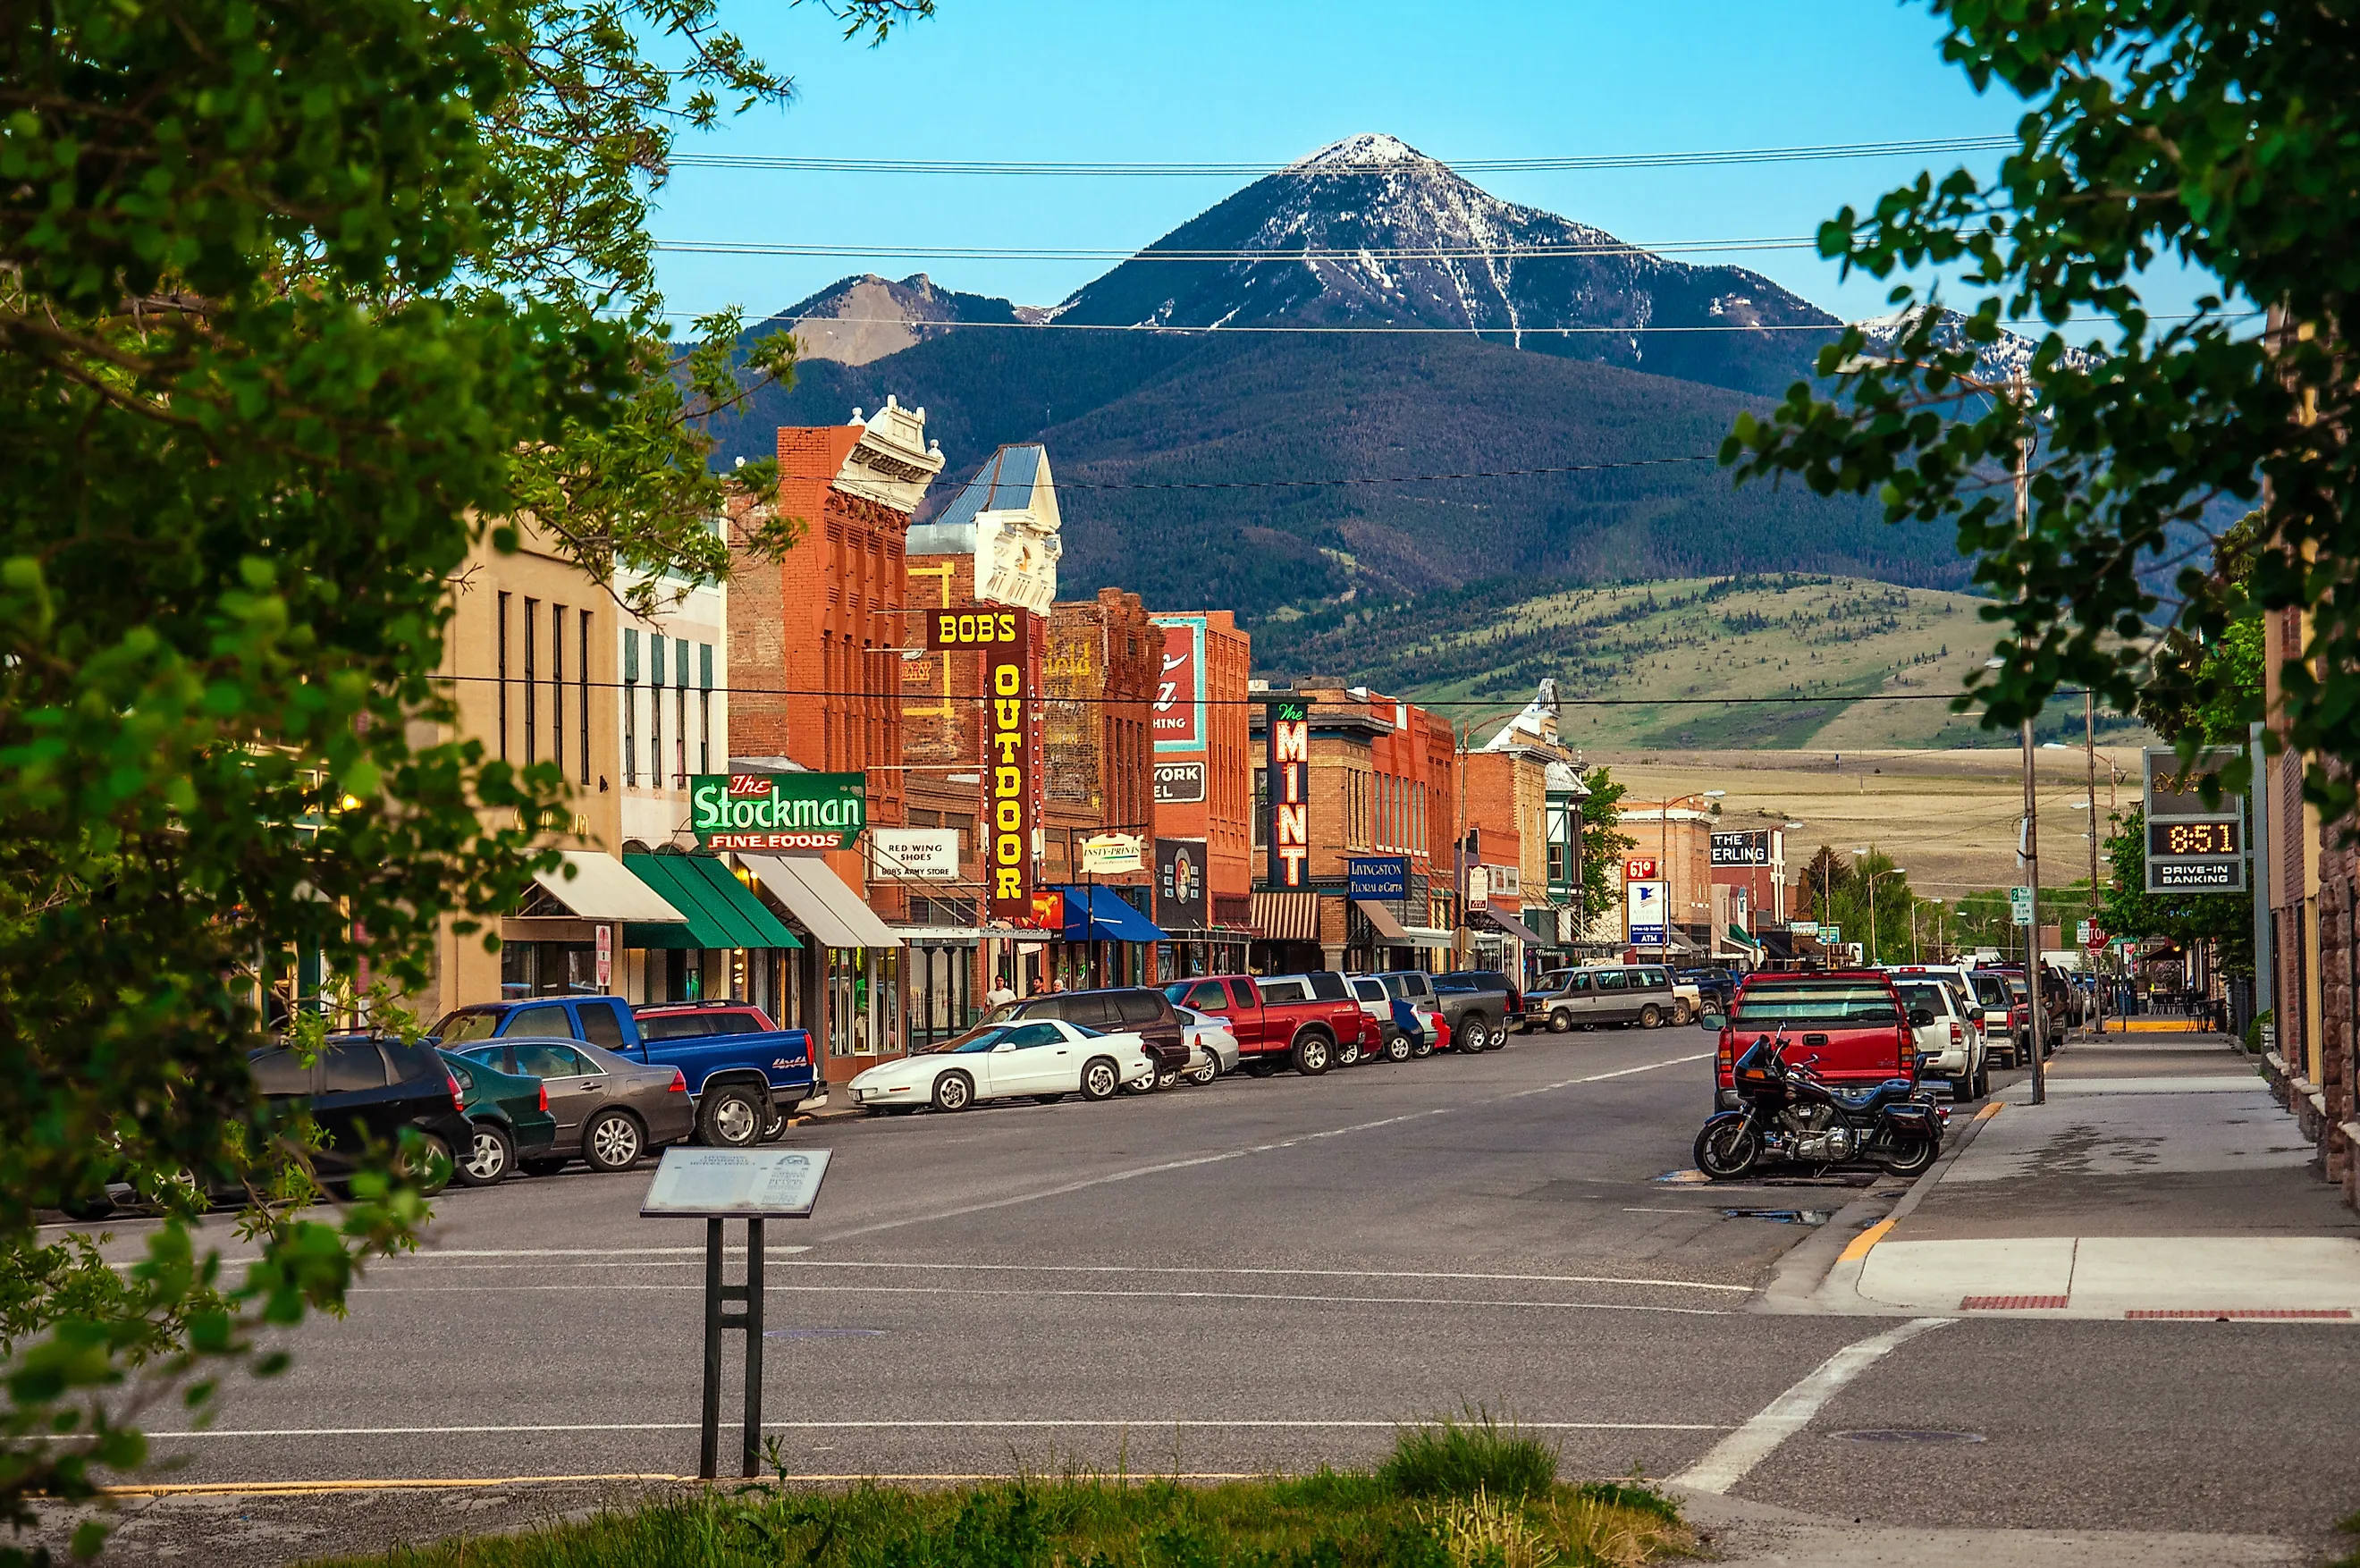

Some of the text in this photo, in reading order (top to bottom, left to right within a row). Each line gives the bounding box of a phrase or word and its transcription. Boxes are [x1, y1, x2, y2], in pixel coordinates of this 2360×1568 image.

[939, 612, 1016, 643] BOB'S
[1278, 704, 1303, 721] The
[729, 775, 771, 794] The
[993, 664, 1022, 899] OUTDOOR
[694, 783, 862, 829] Stockman
[1275, 721, 1309, 886] MINT
[709, 834, 842, 848] FINE FOODS
[1715, 835, 1742, 846] THE
[2170, 825, 2233, 853] 8:51
[1710, 848, 1765, 861] ERLING
[881, 867, 902, 875] BOB'S
[1351, 861, 1402, 875] LIVINGSTON
[2162, 865, 2229, 874] DRIVE-IN
[2162, 874, 2229, 884] BANKING
[2012, 889, 2019, 900] 2
